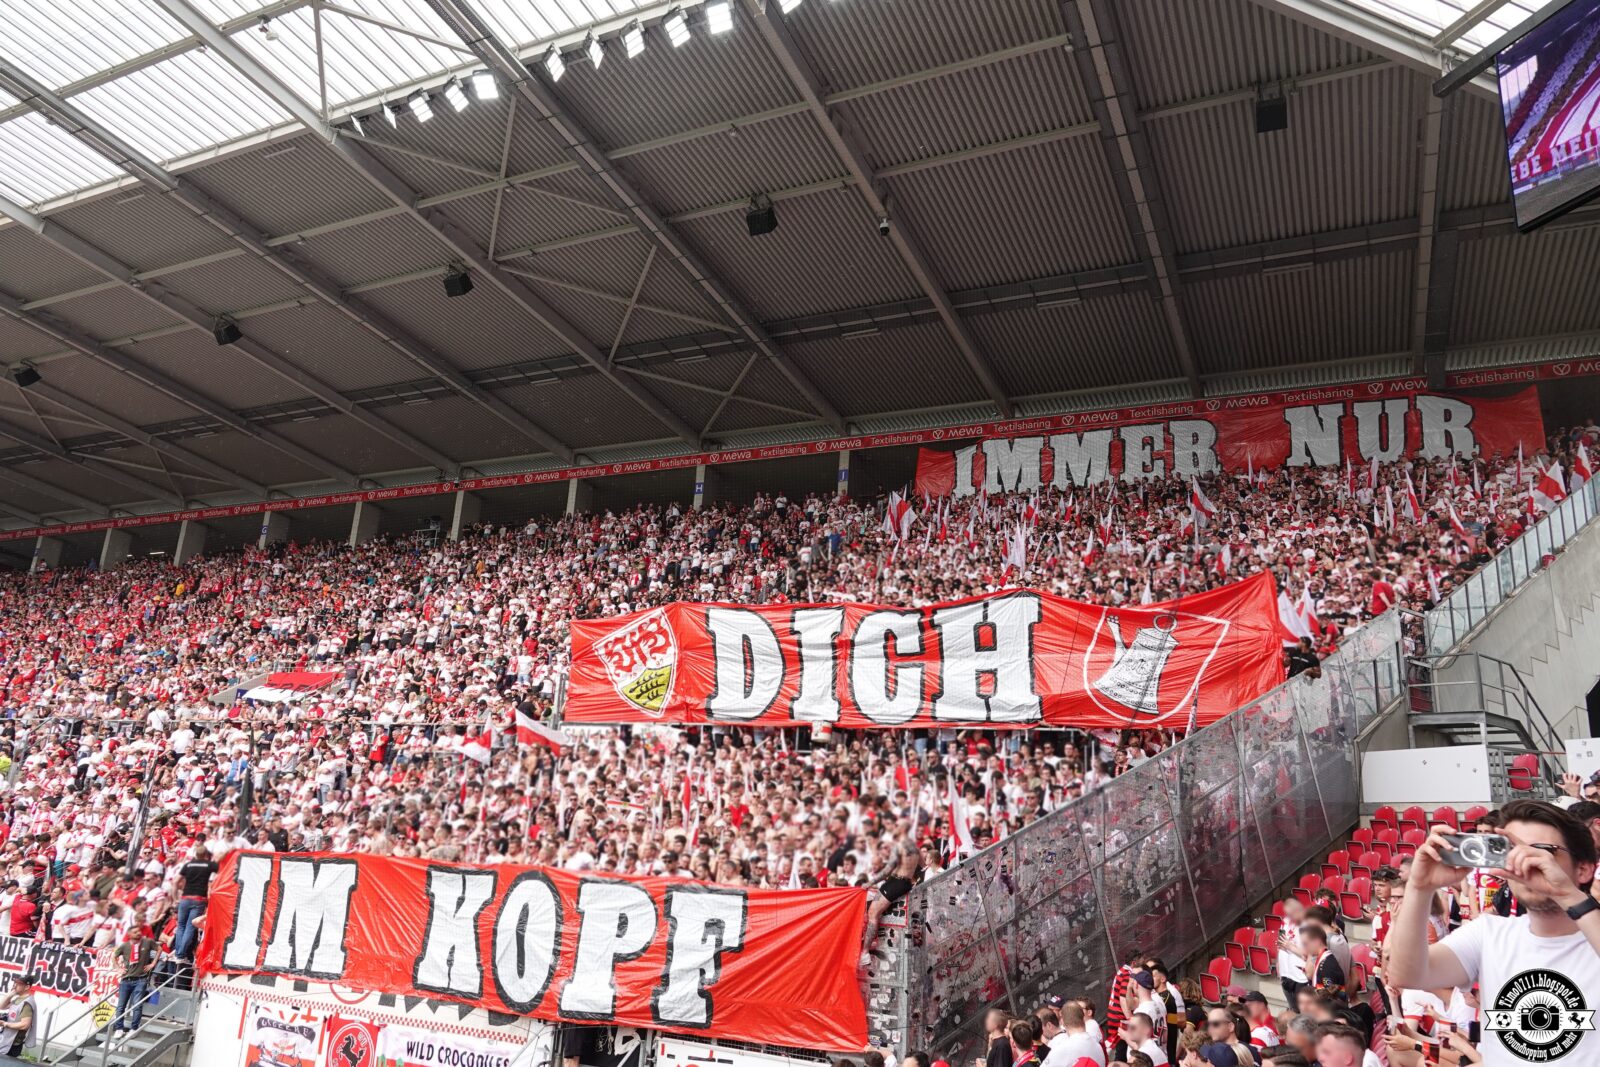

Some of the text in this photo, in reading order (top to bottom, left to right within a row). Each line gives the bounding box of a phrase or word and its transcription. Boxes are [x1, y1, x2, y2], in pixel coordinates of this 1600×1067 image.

[1550, 127, 1600, 167] MEI
[1454, 369, 1534, 384] Textilsharing
[1282, 388, 1354, 402] Textilsharing
[1130, 405, 1194, 418] Textilsharing
[994, 420, 1050, 433] Textilsharing
[871, 434, 923, 444] Textilsharing
[760, 446, 806, 456] Textilsharing
[952, 394, 1480, 499] IMMER NUR
[659, 457, 702, 468] Textilsharing
[695, 484, 703, 492] H
[262, 526, 268, 534] G
[704, 589, 1044, 725] DICH
[220, 854, 748, 1030] IM KOPF
[406, 1041, 510, 1067] WILD CROCODILES
